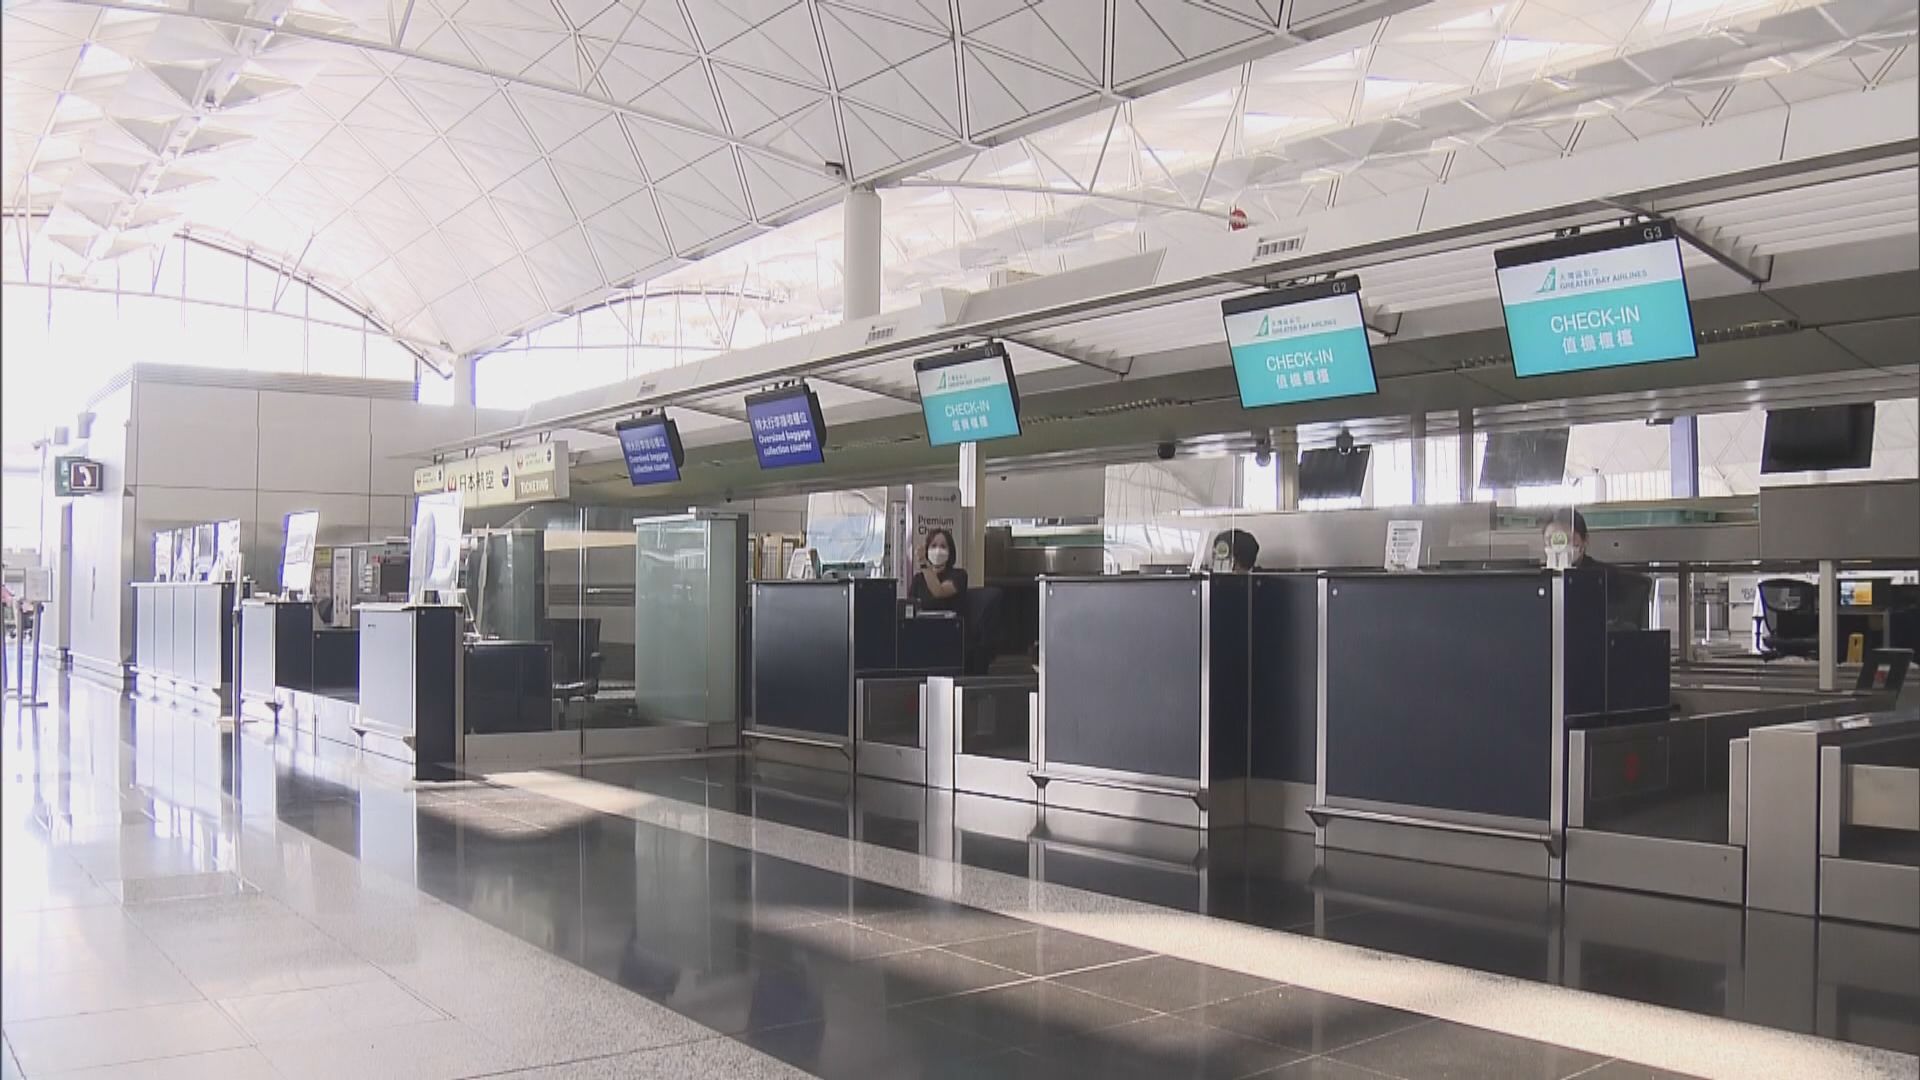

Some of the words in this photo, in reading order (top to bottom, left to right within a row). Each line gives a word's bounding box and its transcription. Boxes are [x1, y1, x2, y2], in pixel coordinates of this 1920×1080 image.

[1643, 226, 1662, 240] G3
[1560, 278, 1594, 289] GREATER
[1596, 275, 1610, 284] BAY
[1612, 269, 1648, 281] AIRLINES
[1332, 282, 1347, 293] G2
[1551, 305, 1640, 333] CHECK-IN
[1266, 347, 1334, 372] CHECK-IN
[944, 400, 990, 417] CHECK-IN
[758, 431, 786, 444] Oversized
[785, 429, 811, 442] baggage
[763, 445, 790, 457] collection
[790, 441, 812, 453] counter
[459, 470, 495, 492] 日本航空
[918, 515, 954, 526] Premium
